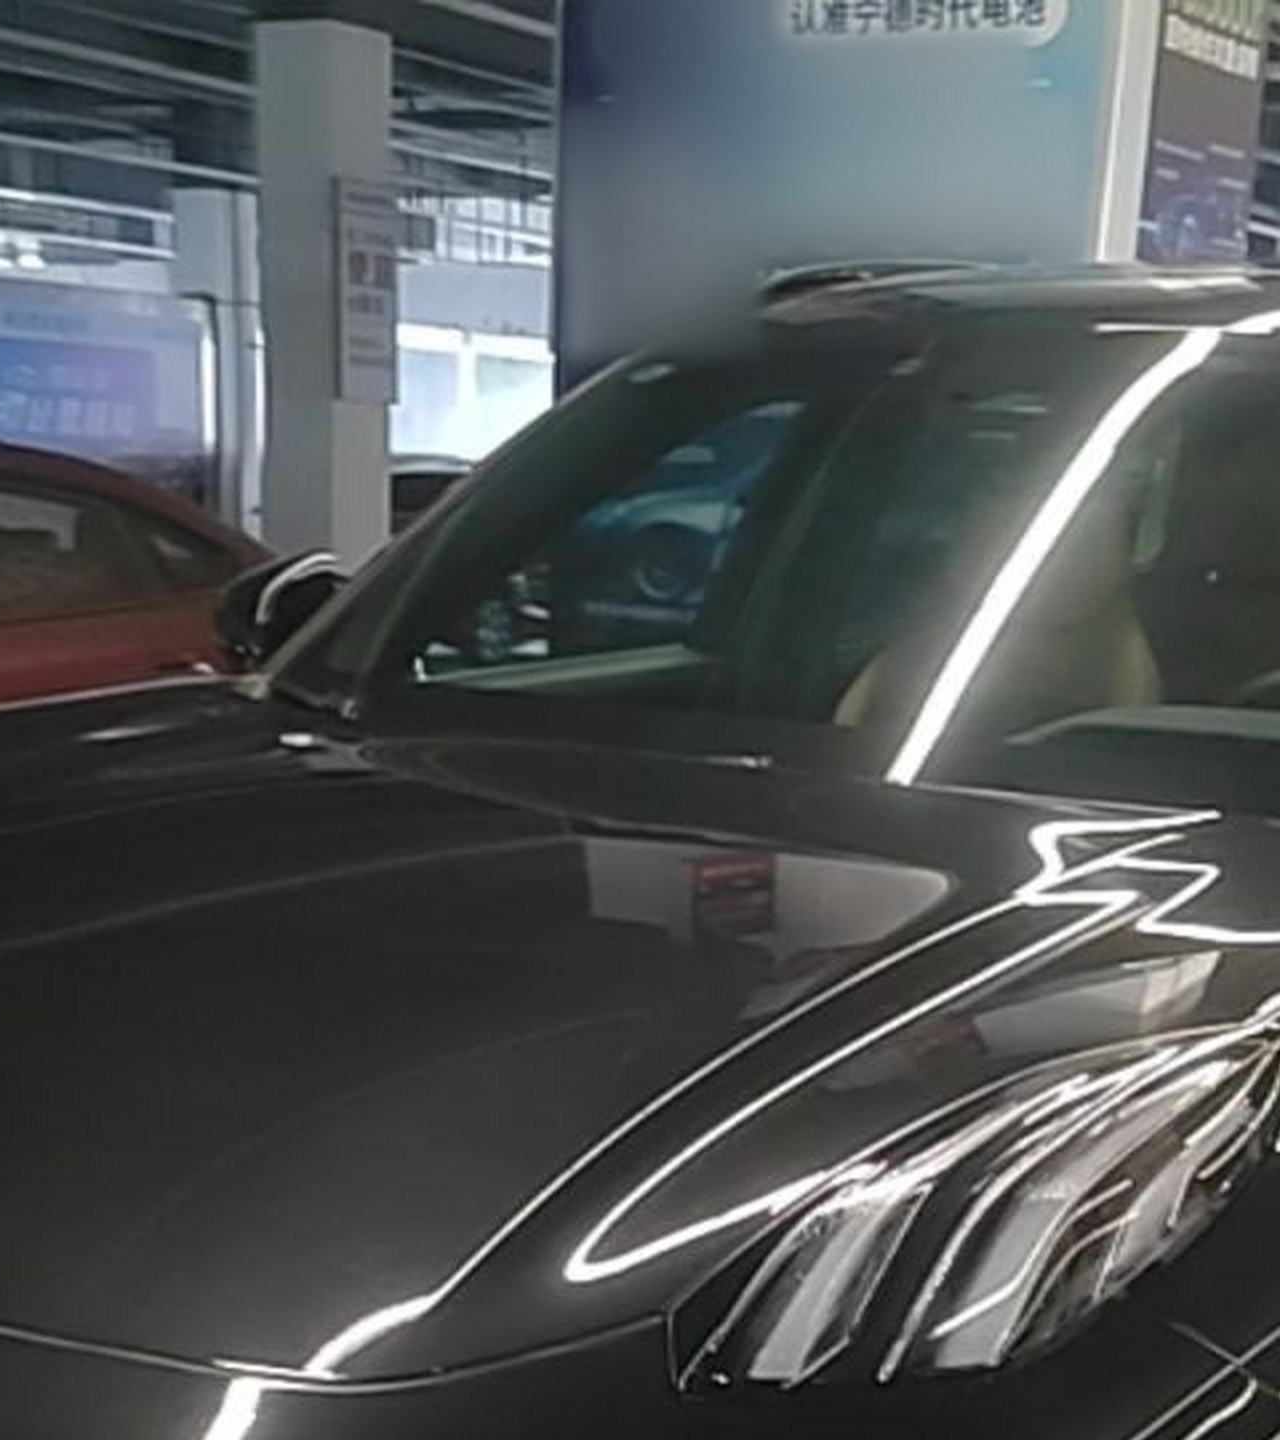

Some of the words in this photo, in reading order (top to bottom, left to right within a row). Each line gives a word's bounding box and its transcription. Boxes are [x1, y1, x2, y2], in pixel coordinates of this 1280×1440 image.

[789, 0, 1046, 35] 认准宁德时代电池
